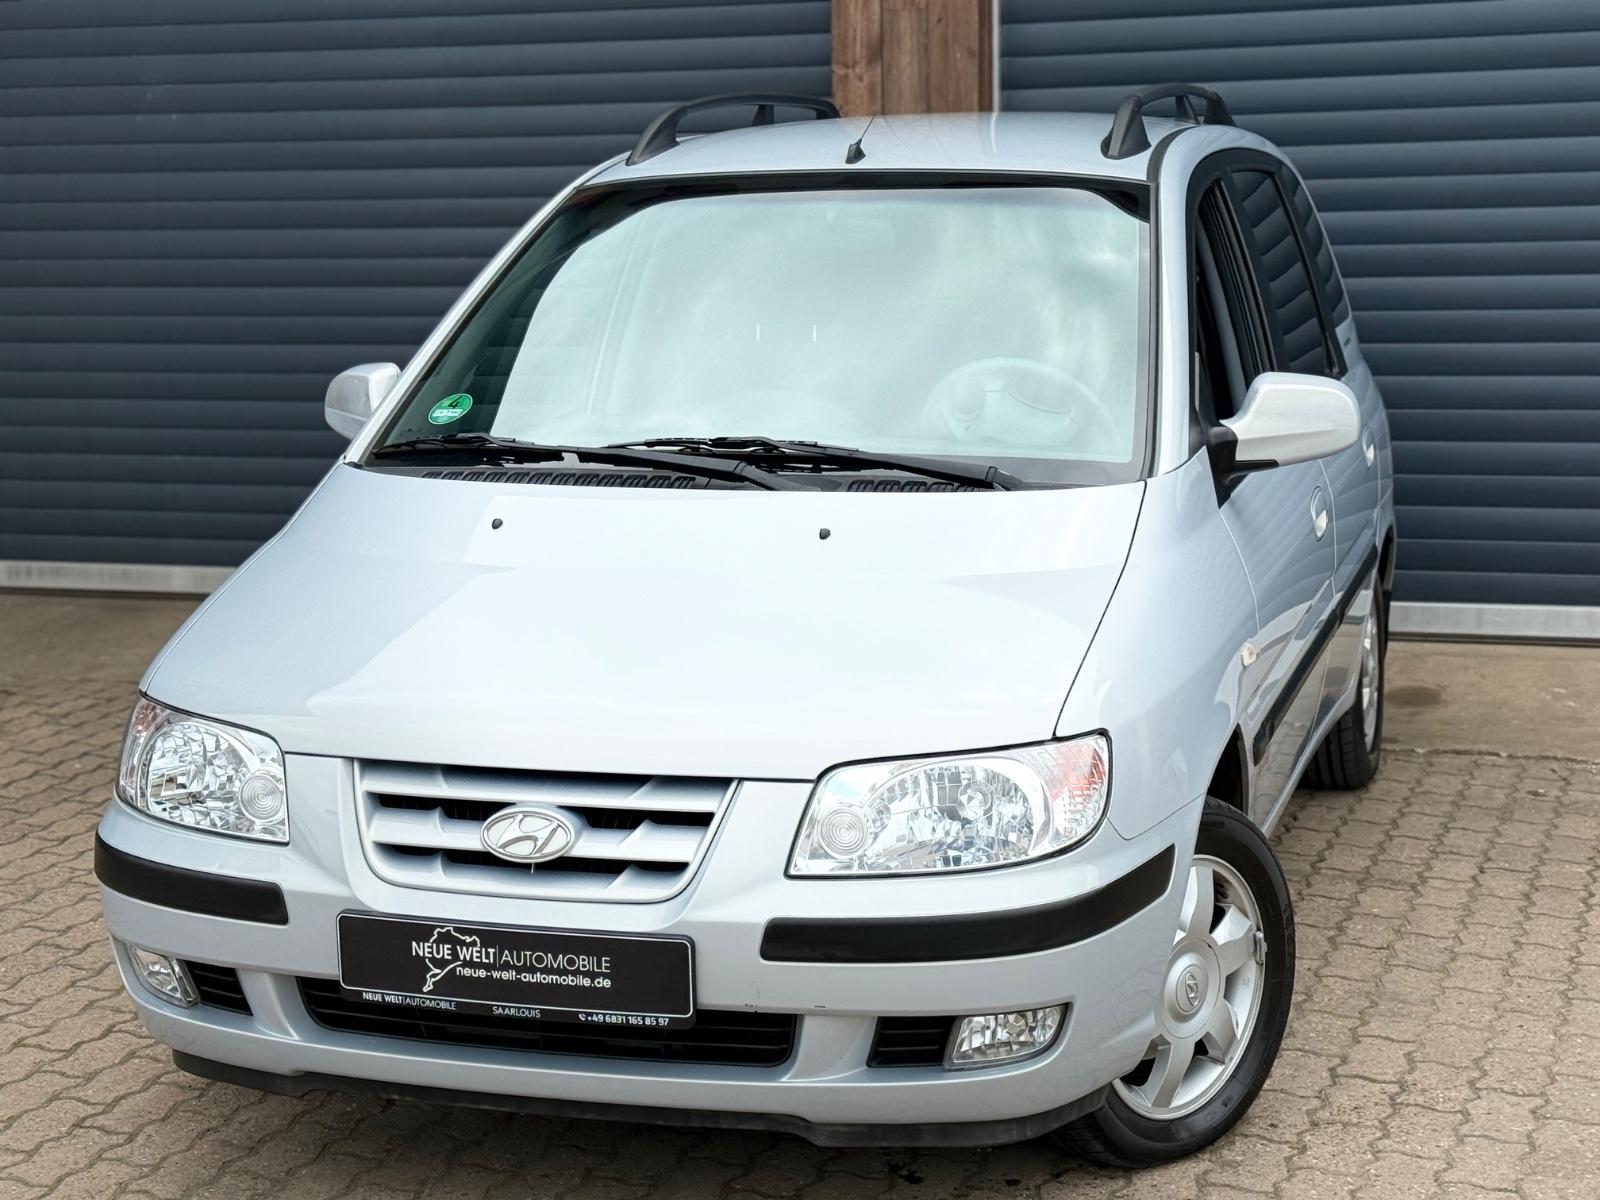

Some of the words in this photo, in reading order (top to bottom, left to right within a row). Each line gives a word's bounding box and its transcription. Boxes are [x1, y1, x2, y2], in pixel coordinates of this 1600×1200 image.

[447, 396, 464, 409] 4
[411, 941, 452, 960] NEUE
[456, 945, 496, 963] WELT
[500, 949, 611, 973] AUTOMOBILE
[456, 966, 611, 988] neue-welt-automobile.de
[362, 992, 383, 1002] NEUE
[384, 994, 403, 1004] WELT
[405, 997, 457, 1010] AUTOMOBILE
[492, 1006, 541, 1018] SAARLOUIS
[587, 1014, 604, 1022] +49
[605, 1014, 626, 1024] 6831
[628, 1016, 643, 1025] 165
[645, 1017, 657, 1026] 85
[658, 1018, 669, 1026] 97
